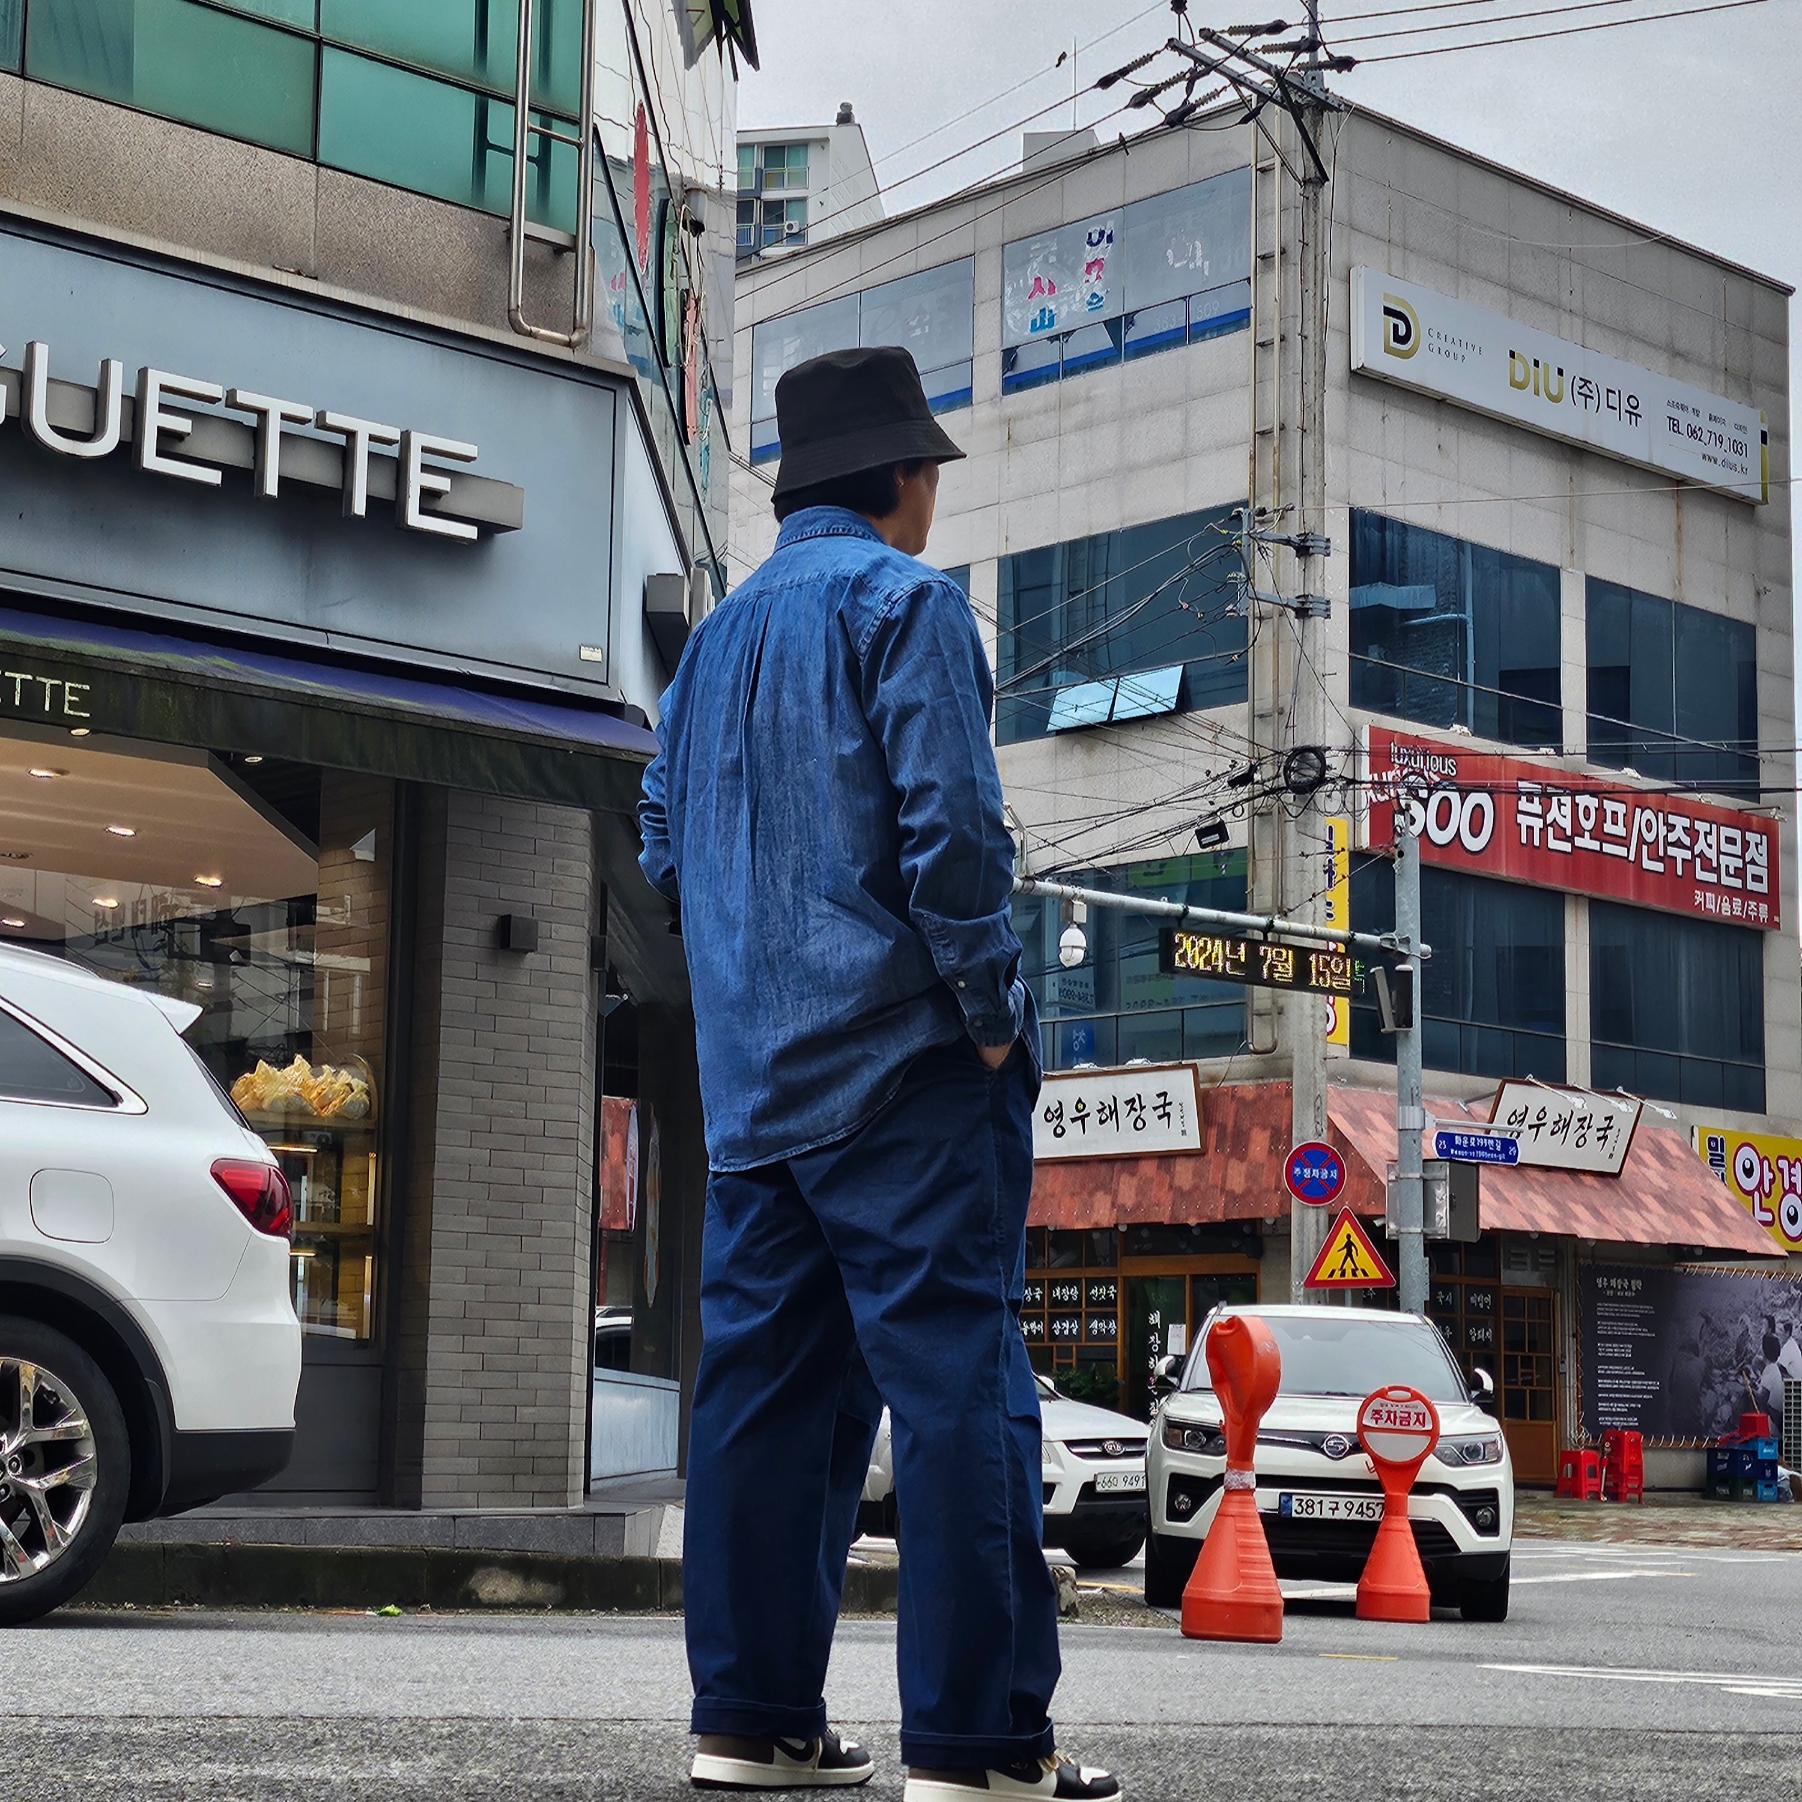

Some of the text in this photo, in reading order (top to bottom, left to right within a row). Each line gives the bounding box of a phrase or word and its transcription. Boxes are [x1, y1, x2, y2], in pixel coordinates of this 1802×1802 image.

[1427, 327, 1483, 356] CREATIVE
[1427, 342, 1467, 363] GROUP
[0, 671, 90, 718] TTE
[1694, 889, 1768, 924] 커피/음료/주류
[1175, 931, 1246, 976] 2024년
[1259, 945, 1294, 983] 7월
[1308, 952, 1351, 991] 15일
[1043, 1091, 1173, 1139] 영우해장국
[1506, 1104, 1615, 1152] 영우해장국
[1293, 1166, 1338, 1180] 주정차금지
[1733, 1142, 1802, 1243] 안경
[1023, 1286, 1043, 1302] 장국
[1052, 1319, 1079, 1336] 삼겹살
[1370, 1409, 1426, 1428] 주차금지
[1294, 1498, 1384, 1520] 381구 9457
